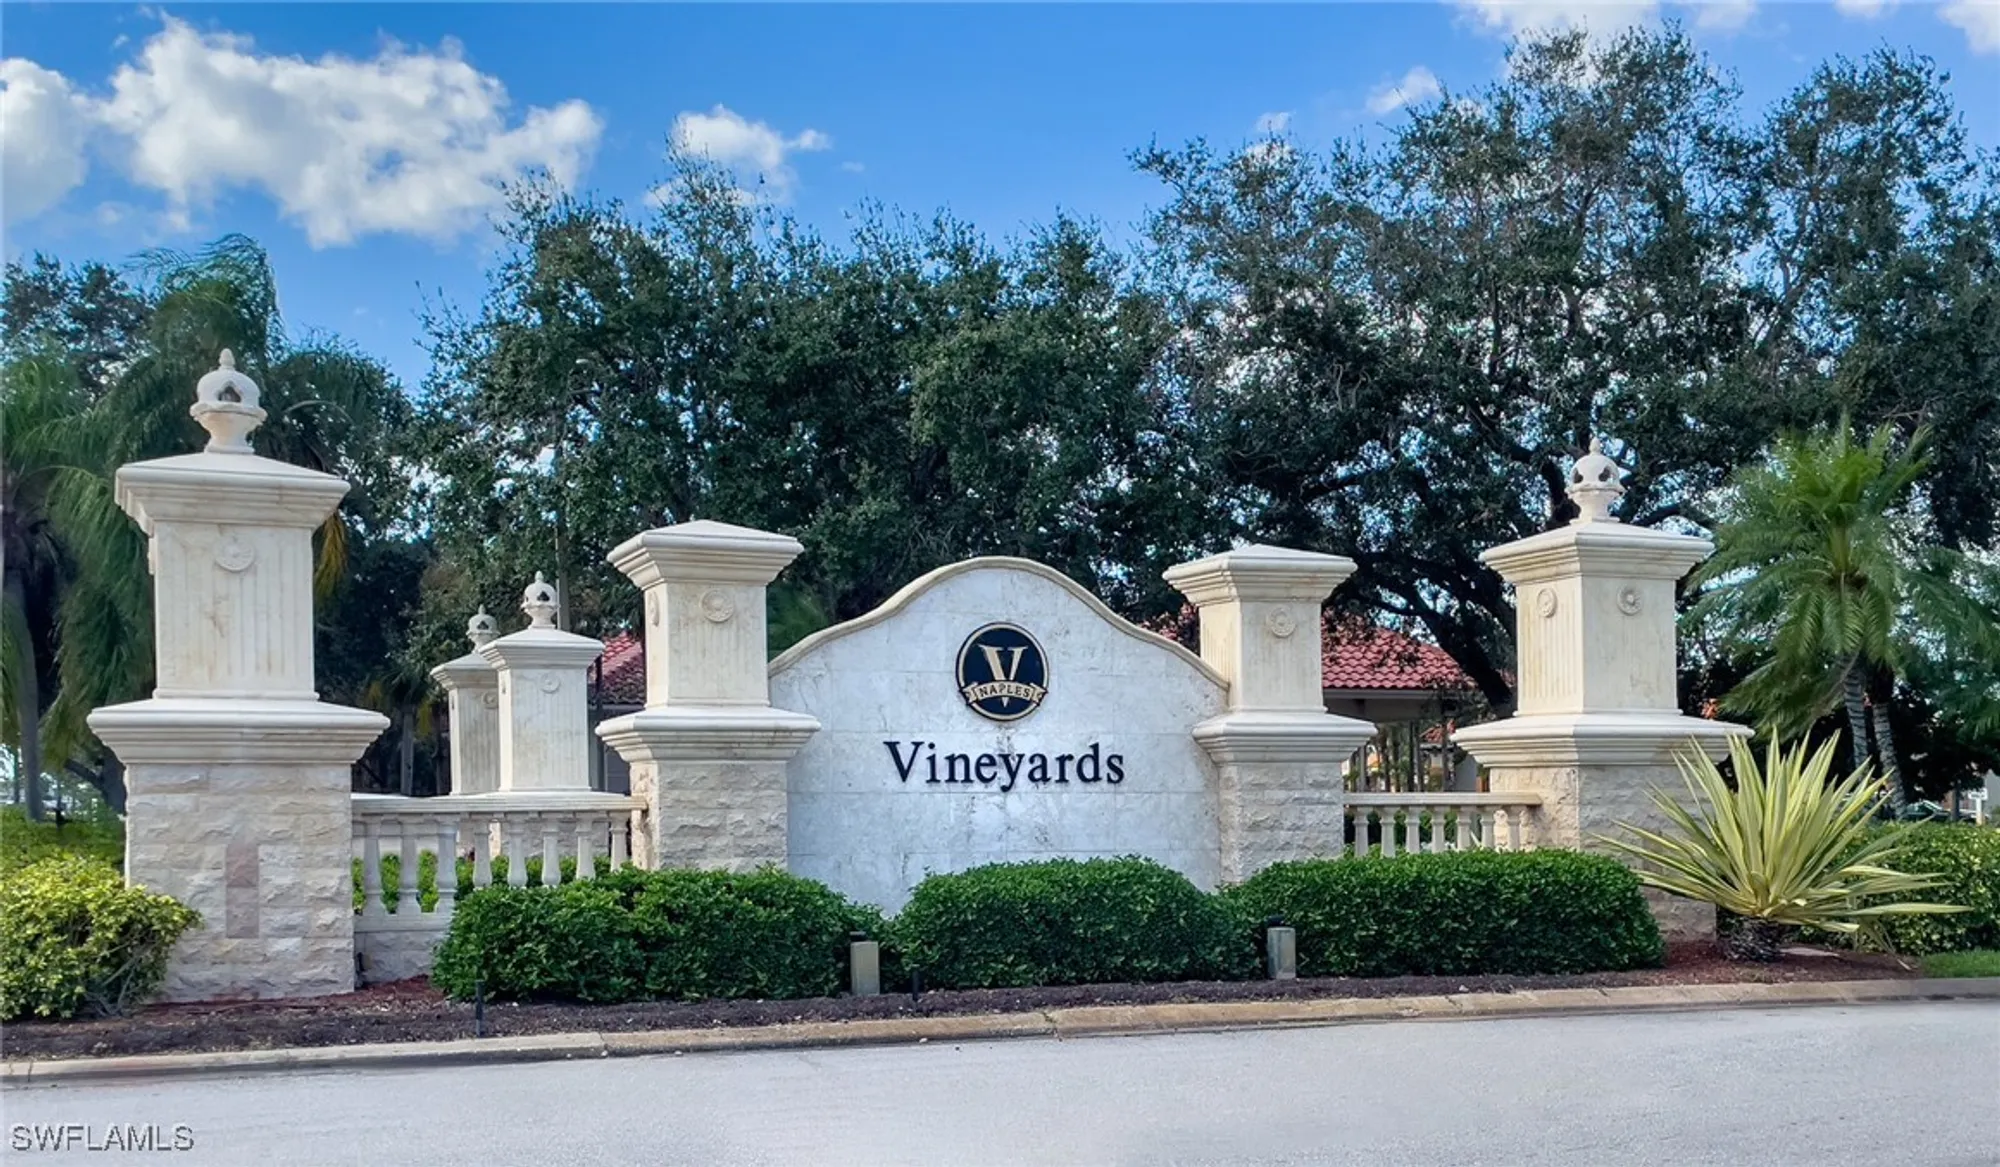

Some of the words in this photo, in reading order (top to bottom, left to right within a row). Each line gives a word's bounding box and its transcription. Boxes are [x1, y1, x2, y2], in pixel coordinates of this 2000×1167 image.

[978, 644, 1028, 708] V
[979, 683, 1031, 697] NAPLES
[883, 741, 1125, 792] Vineyards
